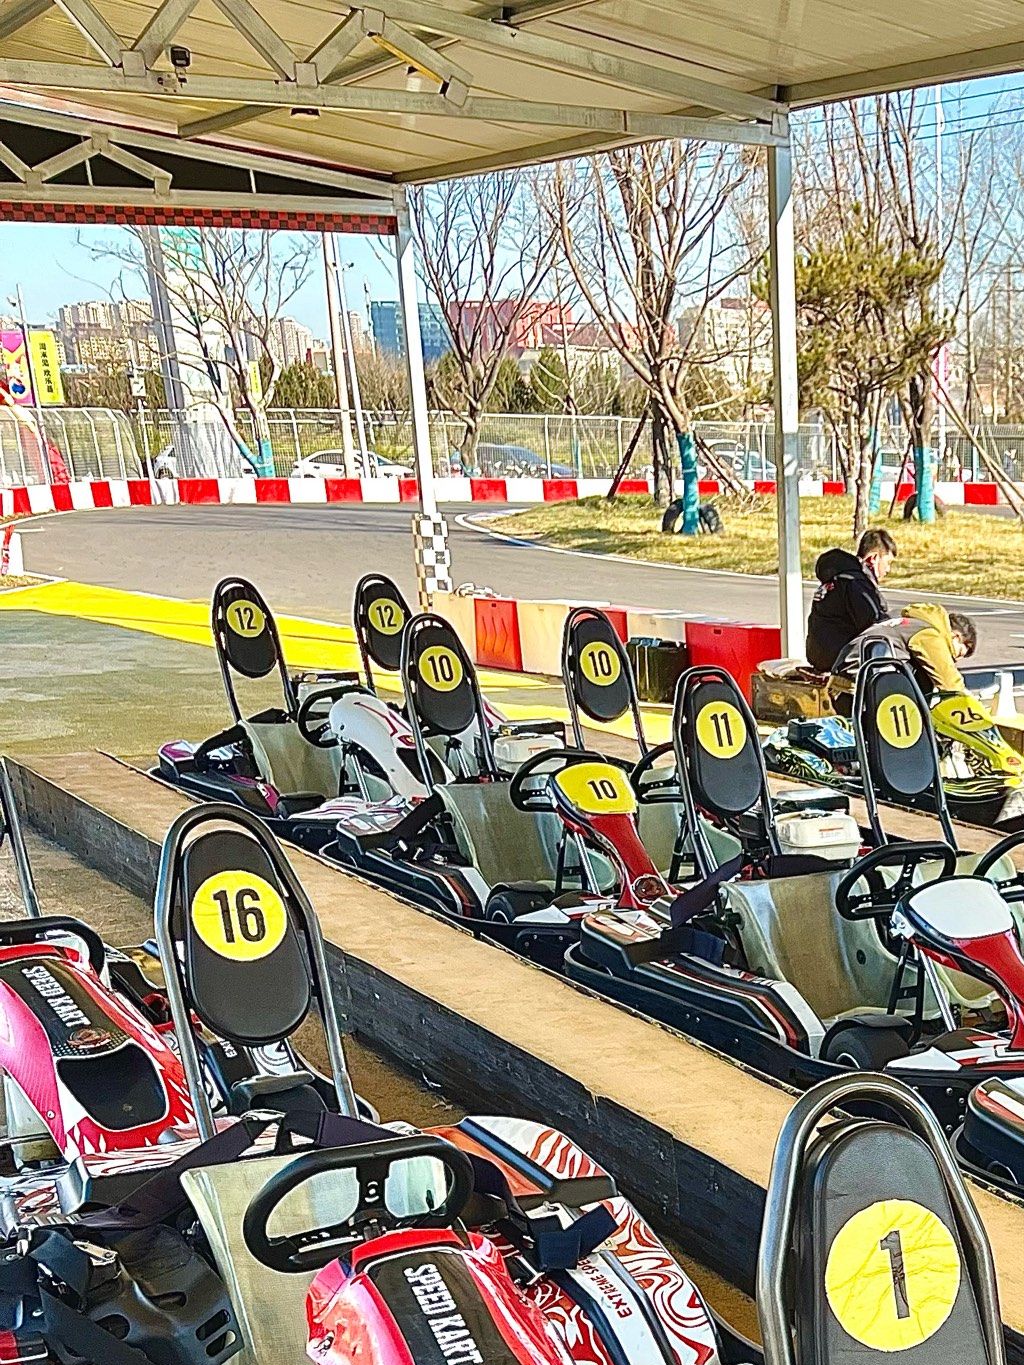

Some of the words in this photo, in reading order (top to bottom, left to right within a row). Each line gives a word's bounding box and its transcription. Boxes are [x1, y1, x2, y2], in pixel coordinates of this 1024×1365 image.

[236, 606, 255, 632] 12
[376, 604, 397, 629] 12
[427, 654, 455, 684] 10
[592, 650, 614, 678] 10
[710, 712, 735, 748] 11
[890, 704, 909, 738] 11
[951, 705, 985, 727] 26
[586, 779, 619, 801] 10
[213, 887, 267, 944] 16
[21, 965, 66, 998] SPEED
[47, 995, 92, 1027] KART
[403, 1263, 457, 1315] SPEED
[879, 1229, 911, 1320] 1
[590, 1274, 633, 1318] EXTREME
